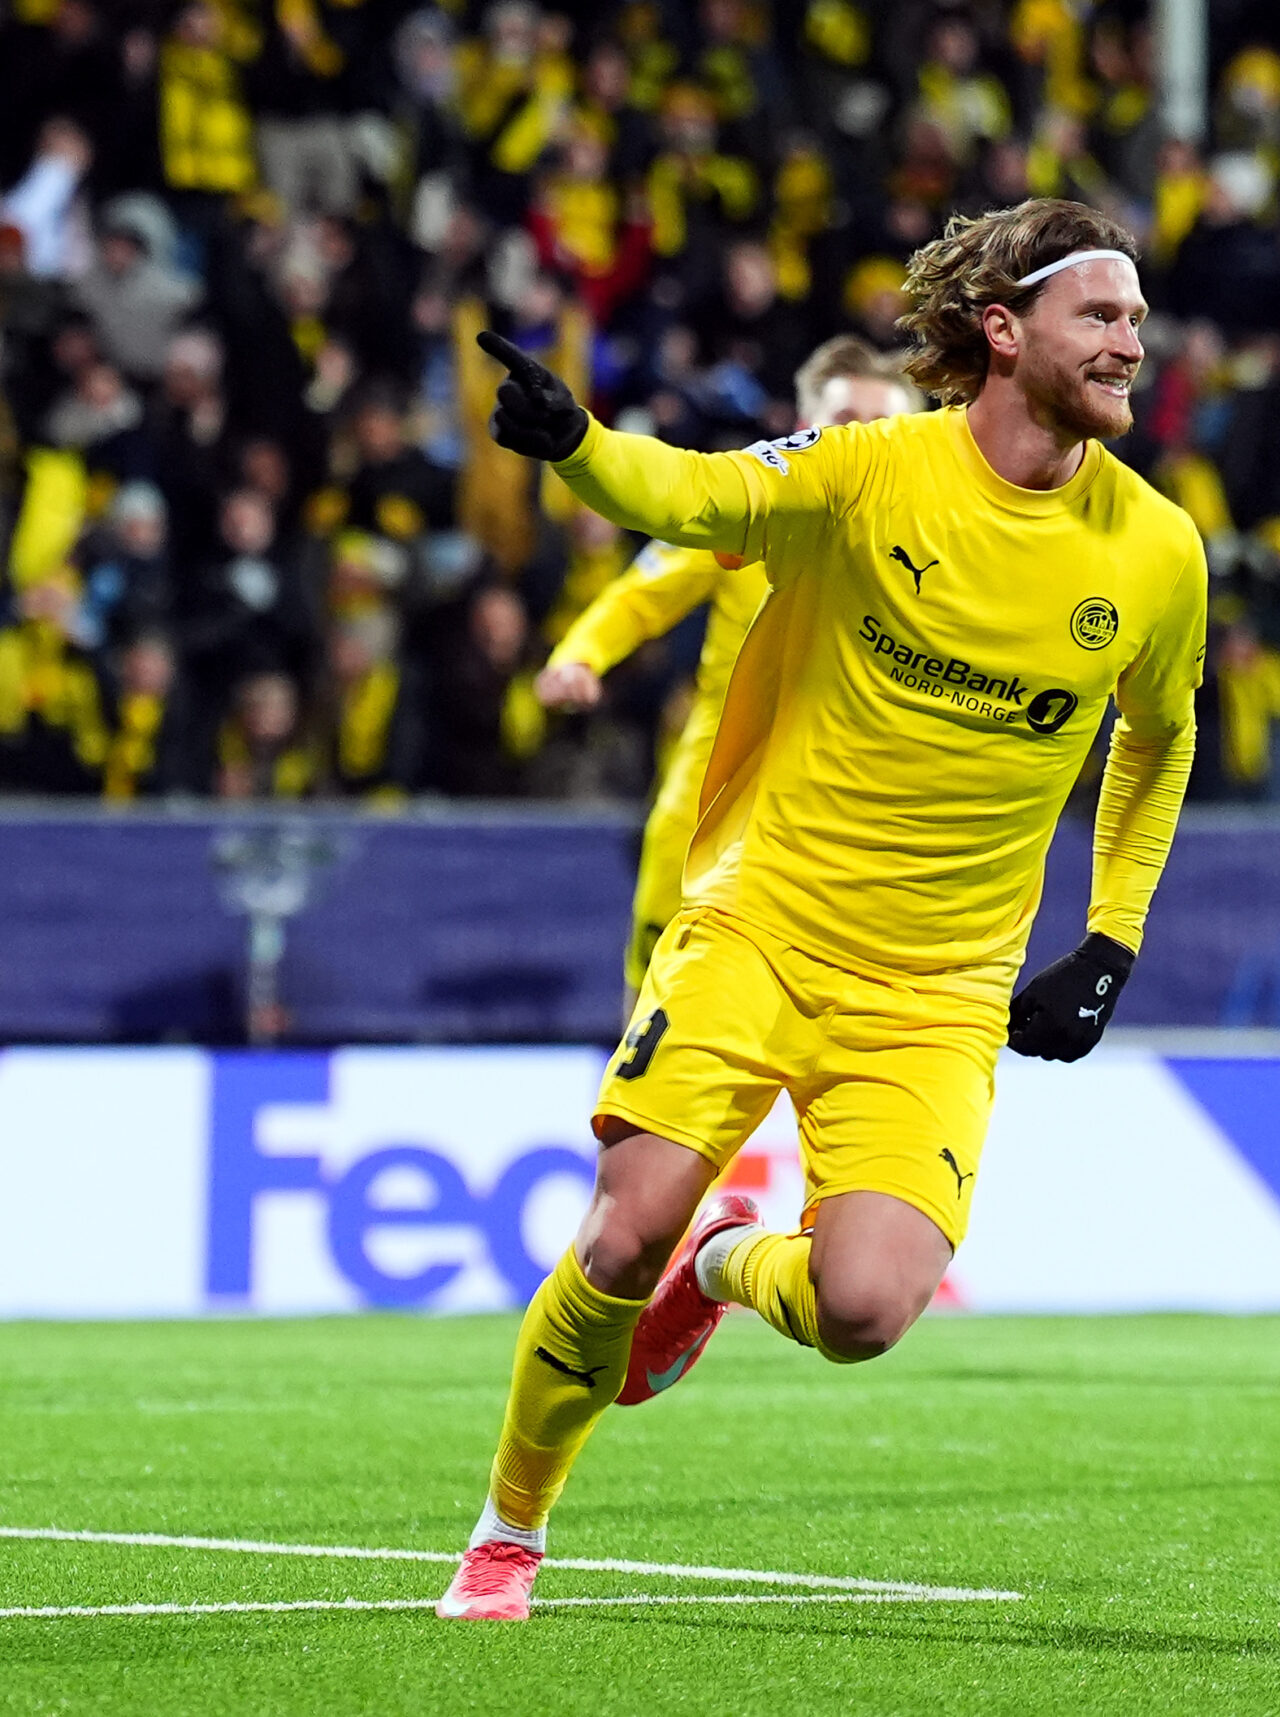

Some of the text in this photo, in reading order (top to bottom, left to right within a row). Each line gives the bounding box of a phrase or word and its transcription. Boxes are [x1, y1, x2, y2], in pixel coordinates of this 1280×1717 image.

[858, 615, 1029, 706] SpareBank
[890, 667, 1019, 724] NORD-NORGE
[1096, 974, 1112, 996] 6
[615, 1007, 670, 1082] 9
